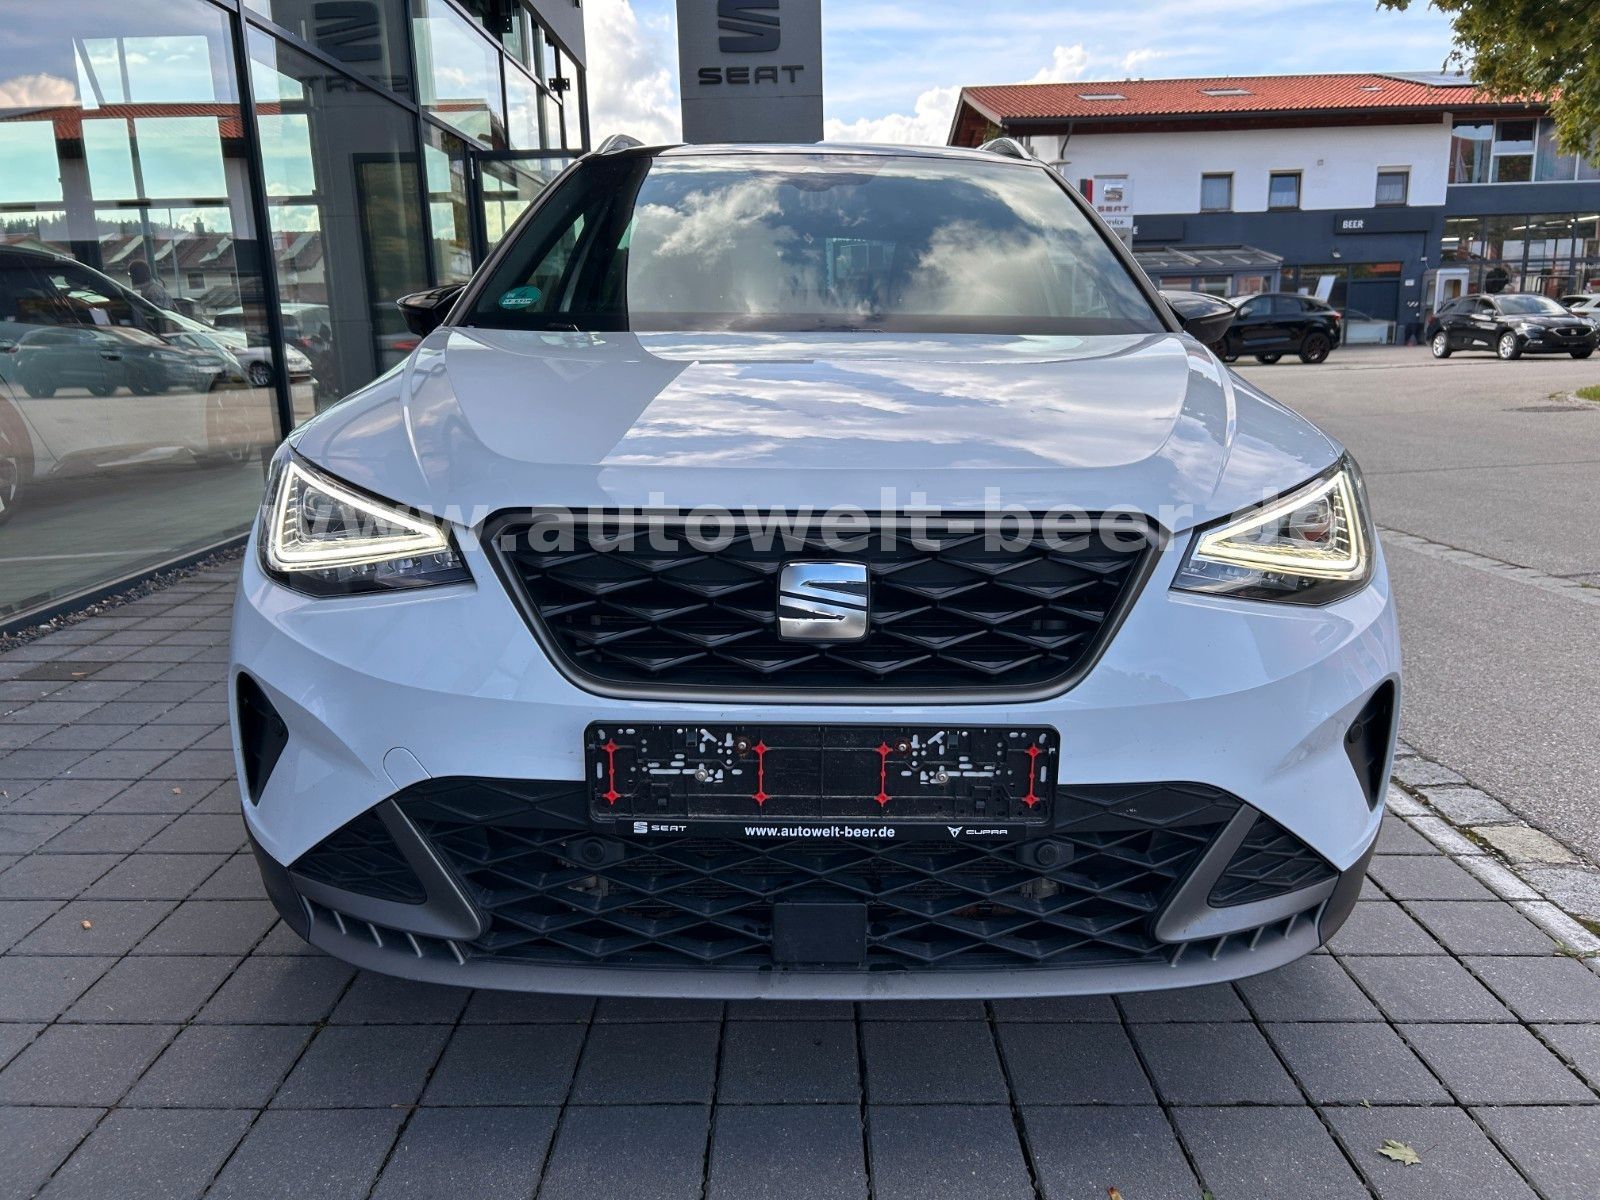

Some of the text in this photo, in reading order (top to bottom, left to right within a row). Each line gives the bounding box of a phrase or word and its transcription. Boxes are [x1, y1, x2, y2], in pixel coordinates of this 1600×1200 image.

[698, 65, 804, 85] SEAT
[1342, 220, 1364, 229] BEER
[745, 826, 895, 837] www.autowelt-beer.de
